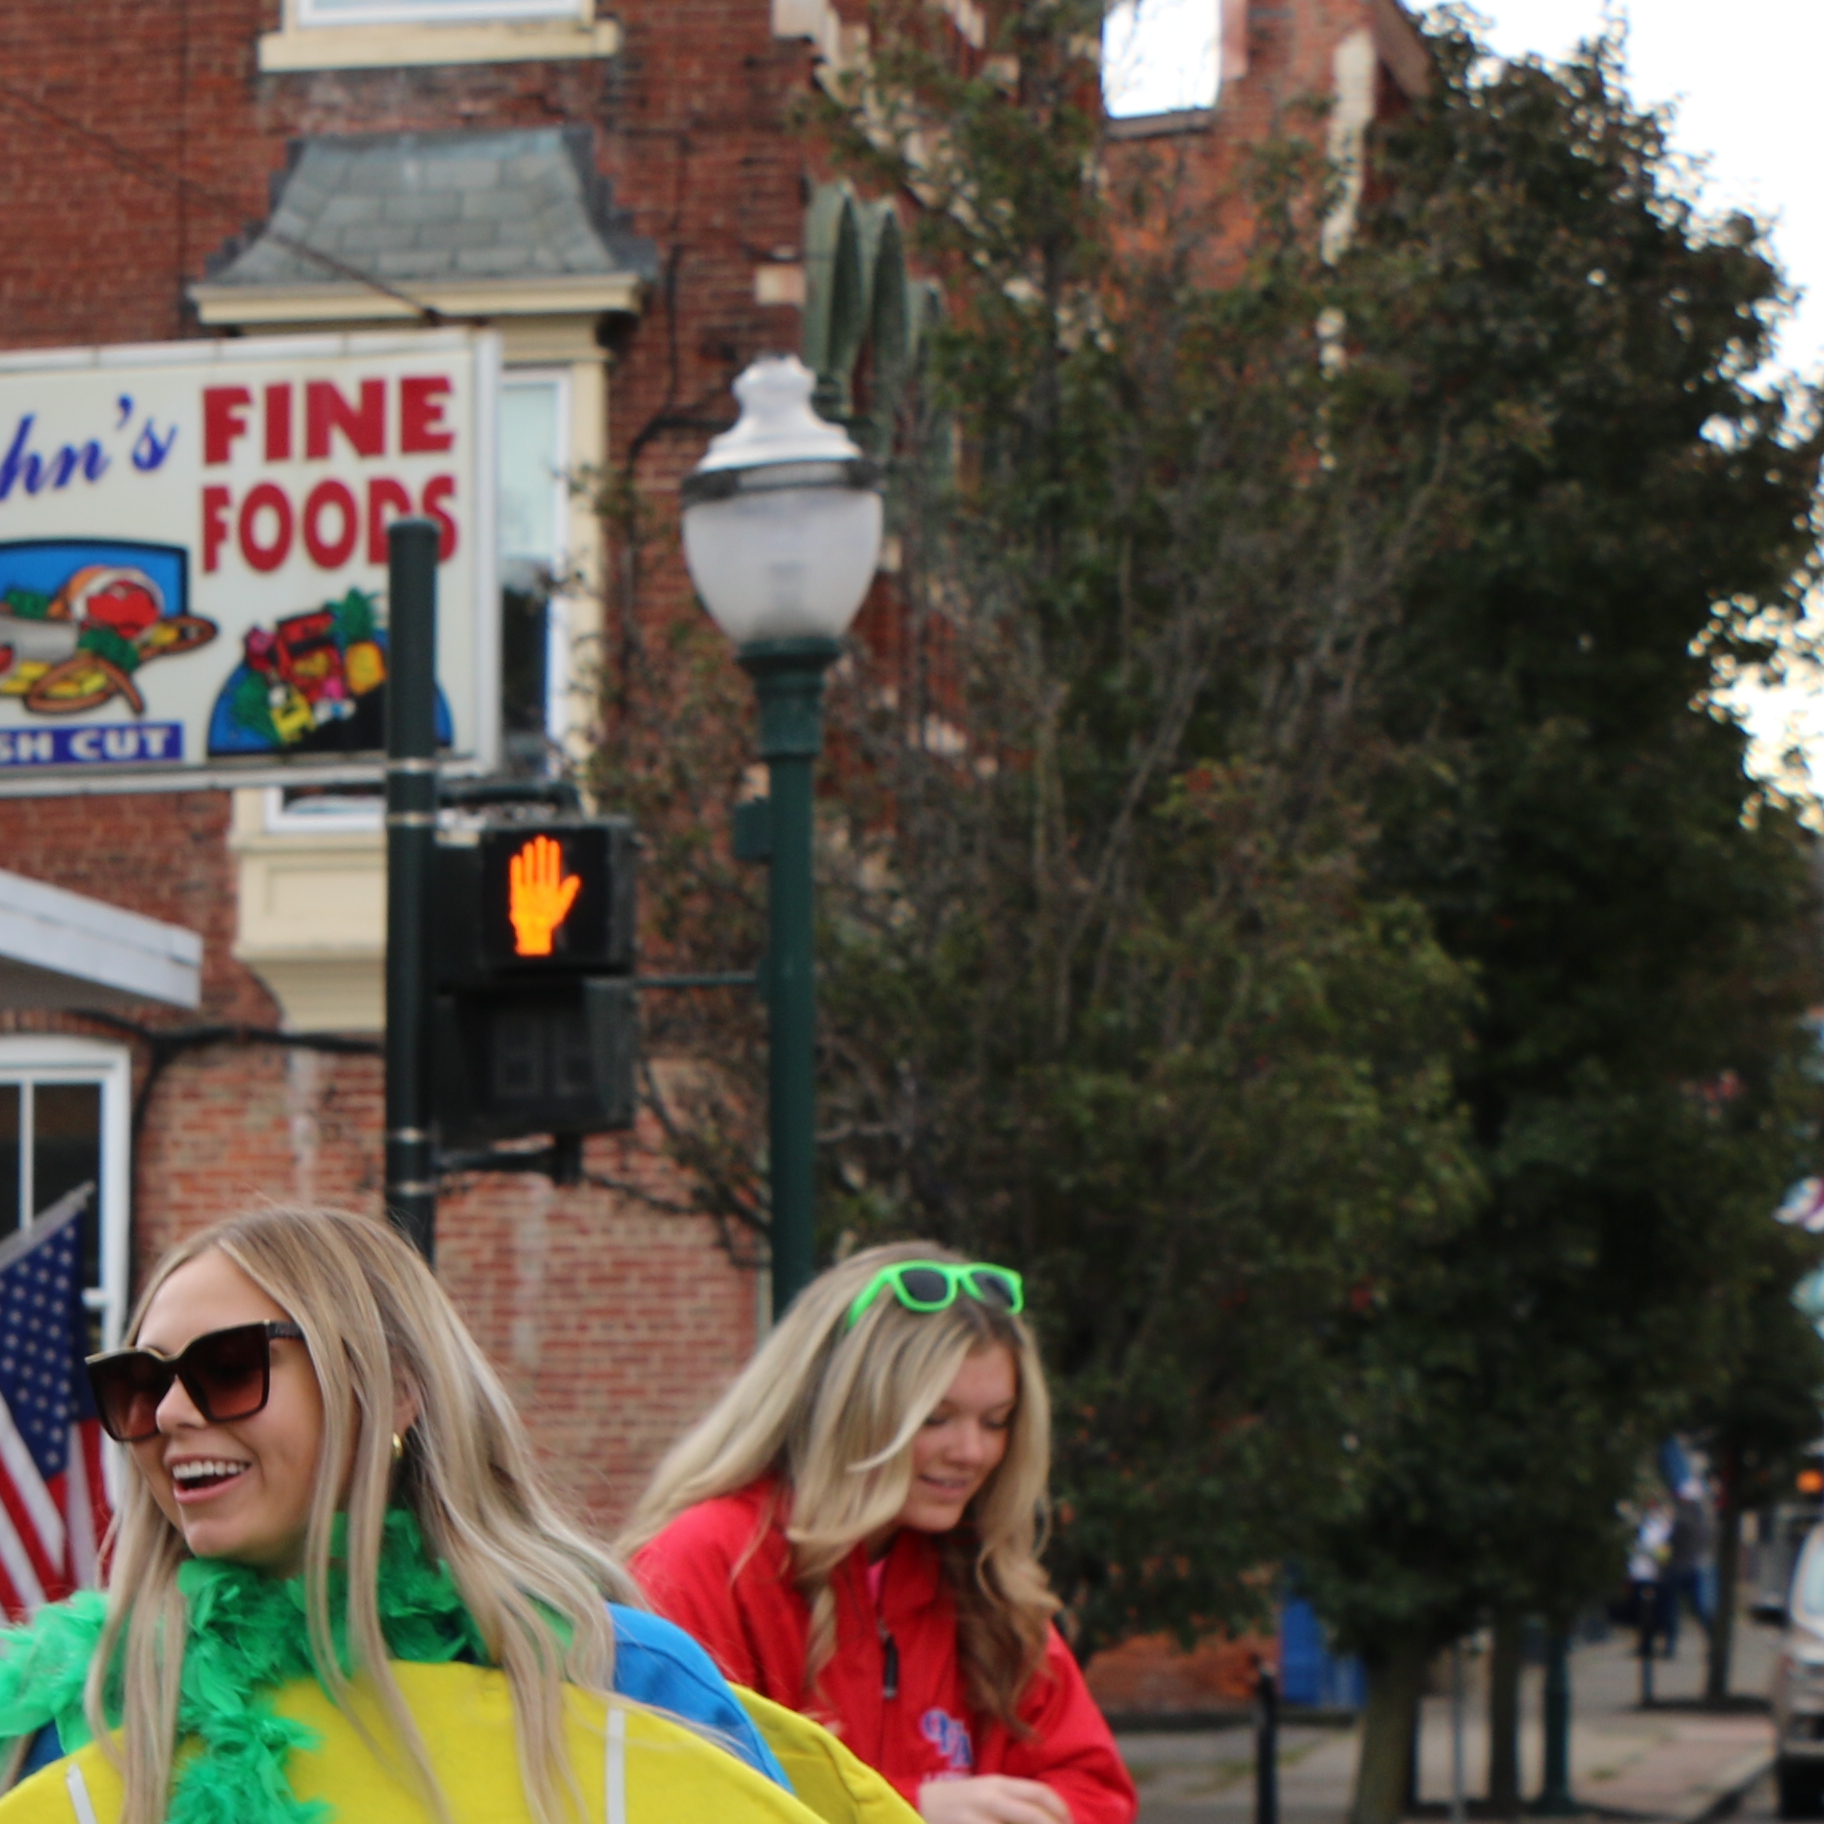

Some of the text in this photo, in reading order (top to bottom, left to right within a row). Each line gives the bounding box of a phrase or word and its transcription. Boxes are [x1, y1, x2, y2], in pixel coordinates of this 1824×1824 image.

[202, 376, 455, 466] FINE
[202, 475, 459, 574] FOODS
[69, 726, 172, 762] CUT
